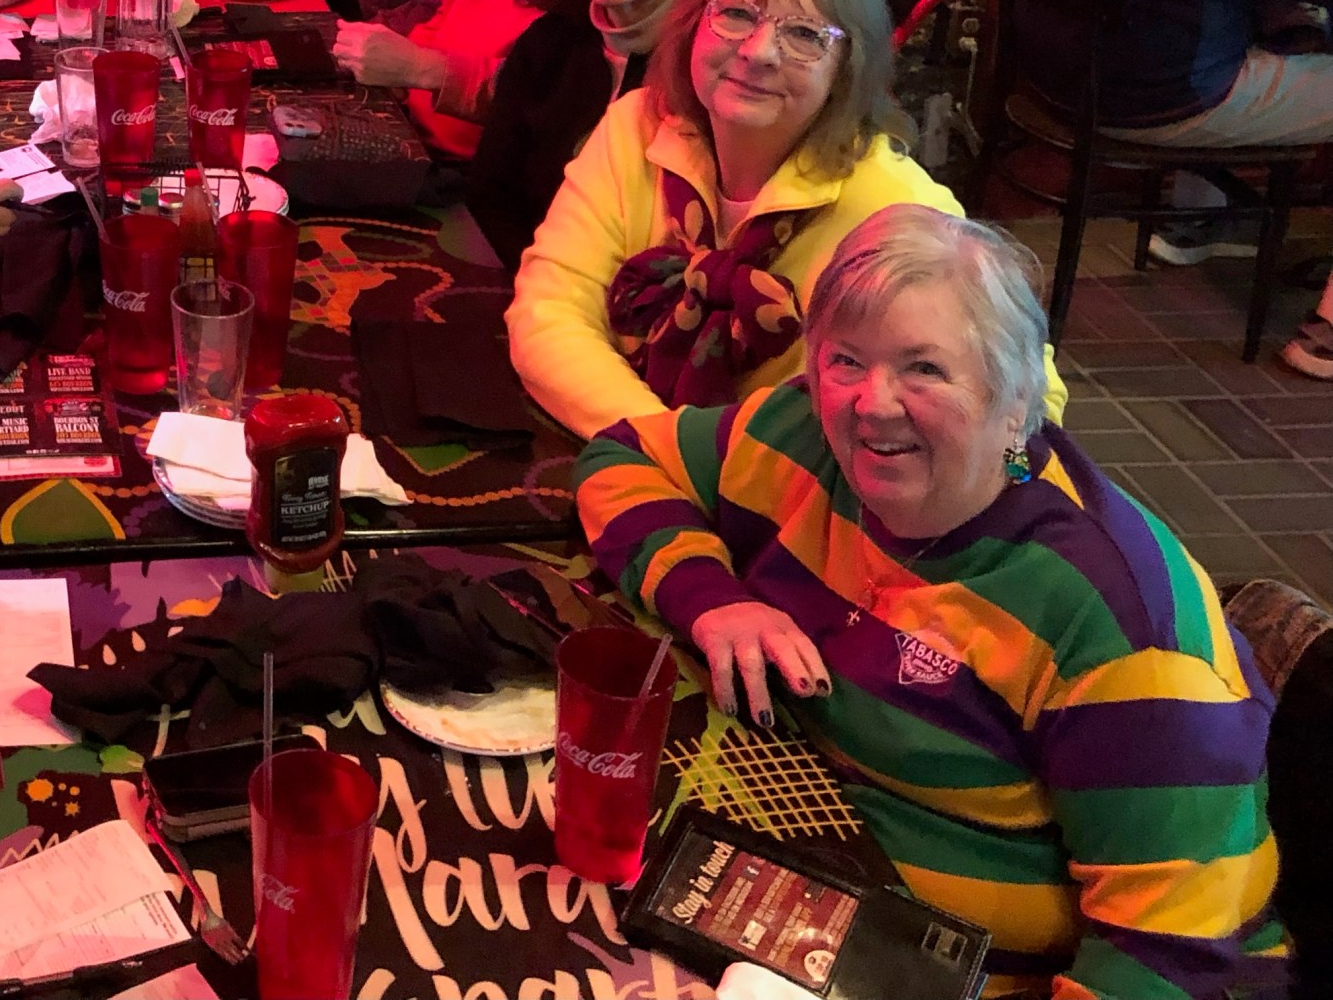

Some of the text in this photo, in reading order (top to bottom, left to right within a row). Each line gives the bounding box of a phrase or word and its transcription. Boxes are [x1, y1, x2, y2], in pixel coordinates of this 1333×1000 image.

[55, 422, 99, 433] BALCONY
[280, 500, 331, 515] KETCHUP
[901, 635, 958, 675] TABASCO
[699, 840, 735, 878] touch
[689, 876, 714, 892] in
[672, 890, 712, 924] Stay
